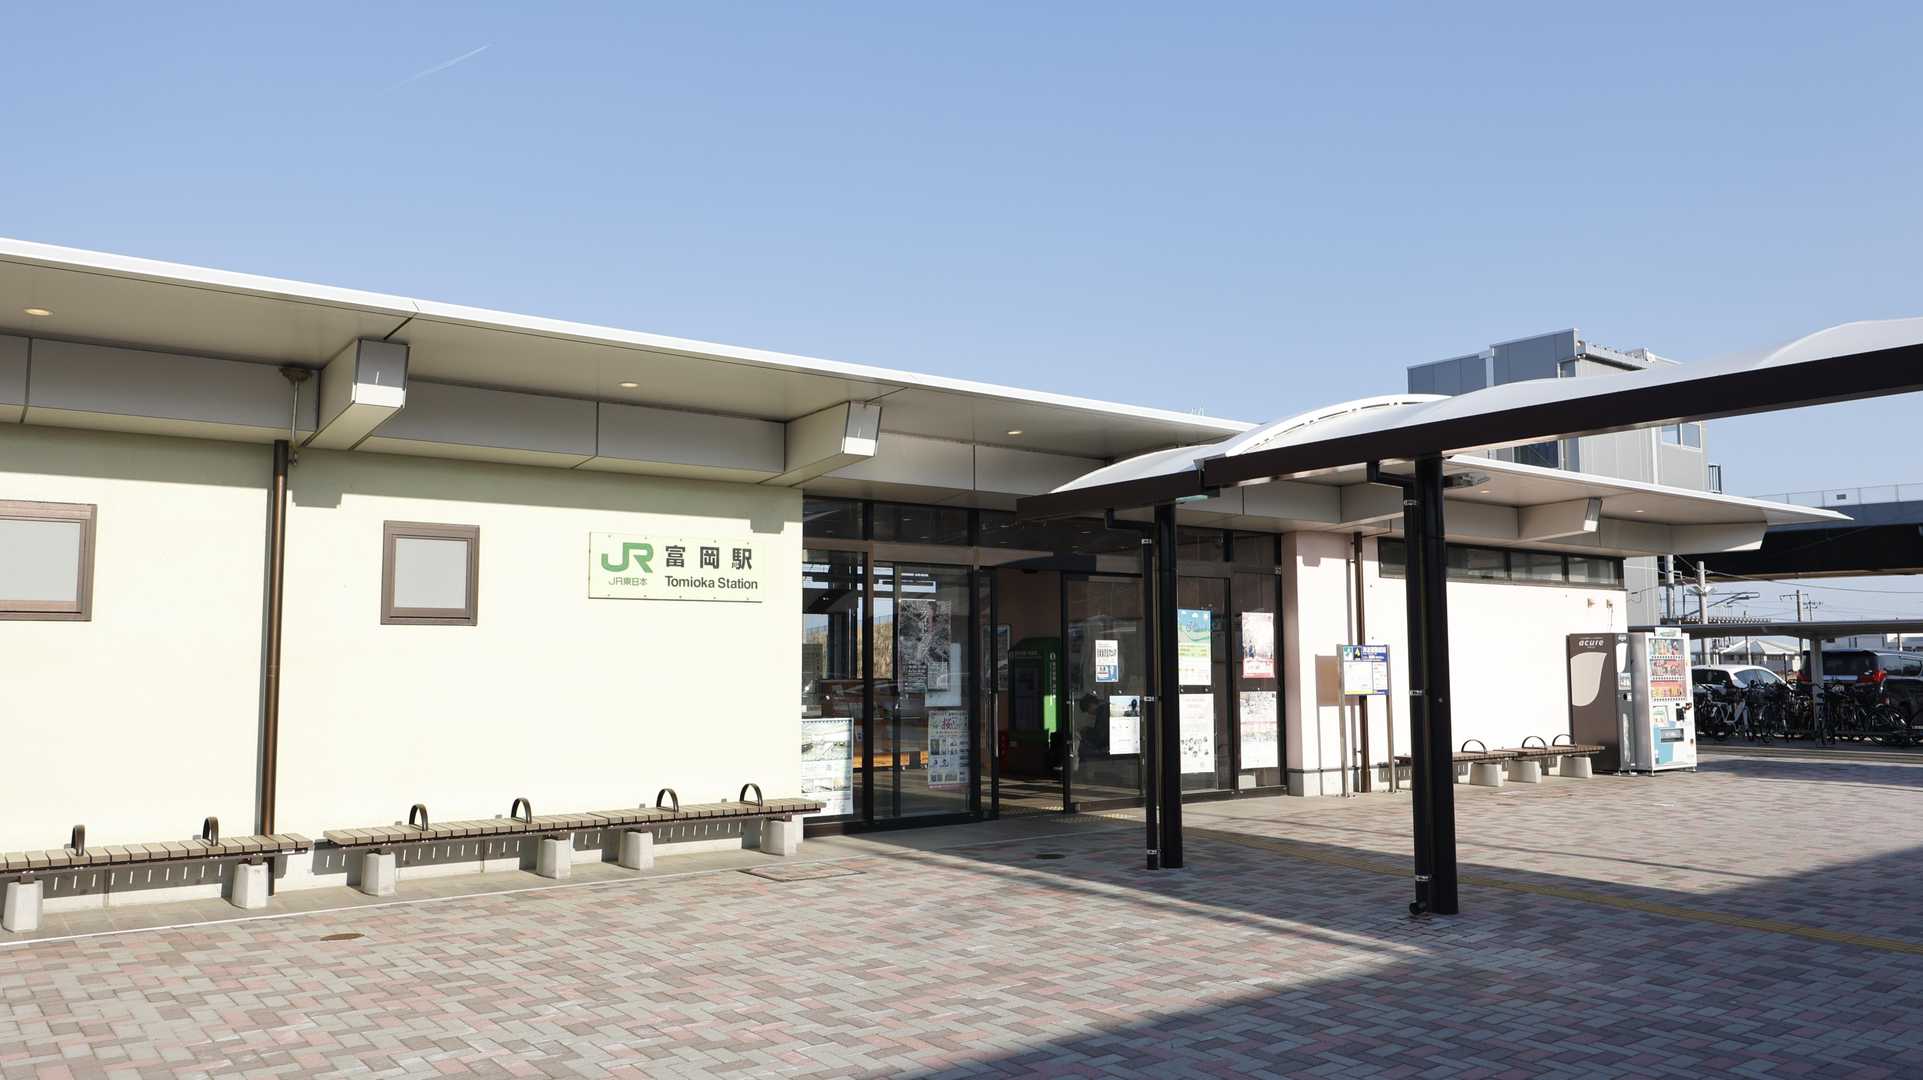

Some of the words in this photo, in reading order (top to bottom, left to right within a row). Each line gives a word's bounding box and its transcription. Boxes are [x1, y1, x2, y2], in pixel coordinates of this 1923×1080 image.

[601, 542, 654, 573] JR
[665, 545, 752, 570] 富岡駅
[608, 577, 648, 586] JR東日本
[665, 576, 715, 588] Tomioka
[718, 578, 758, 589] Station
